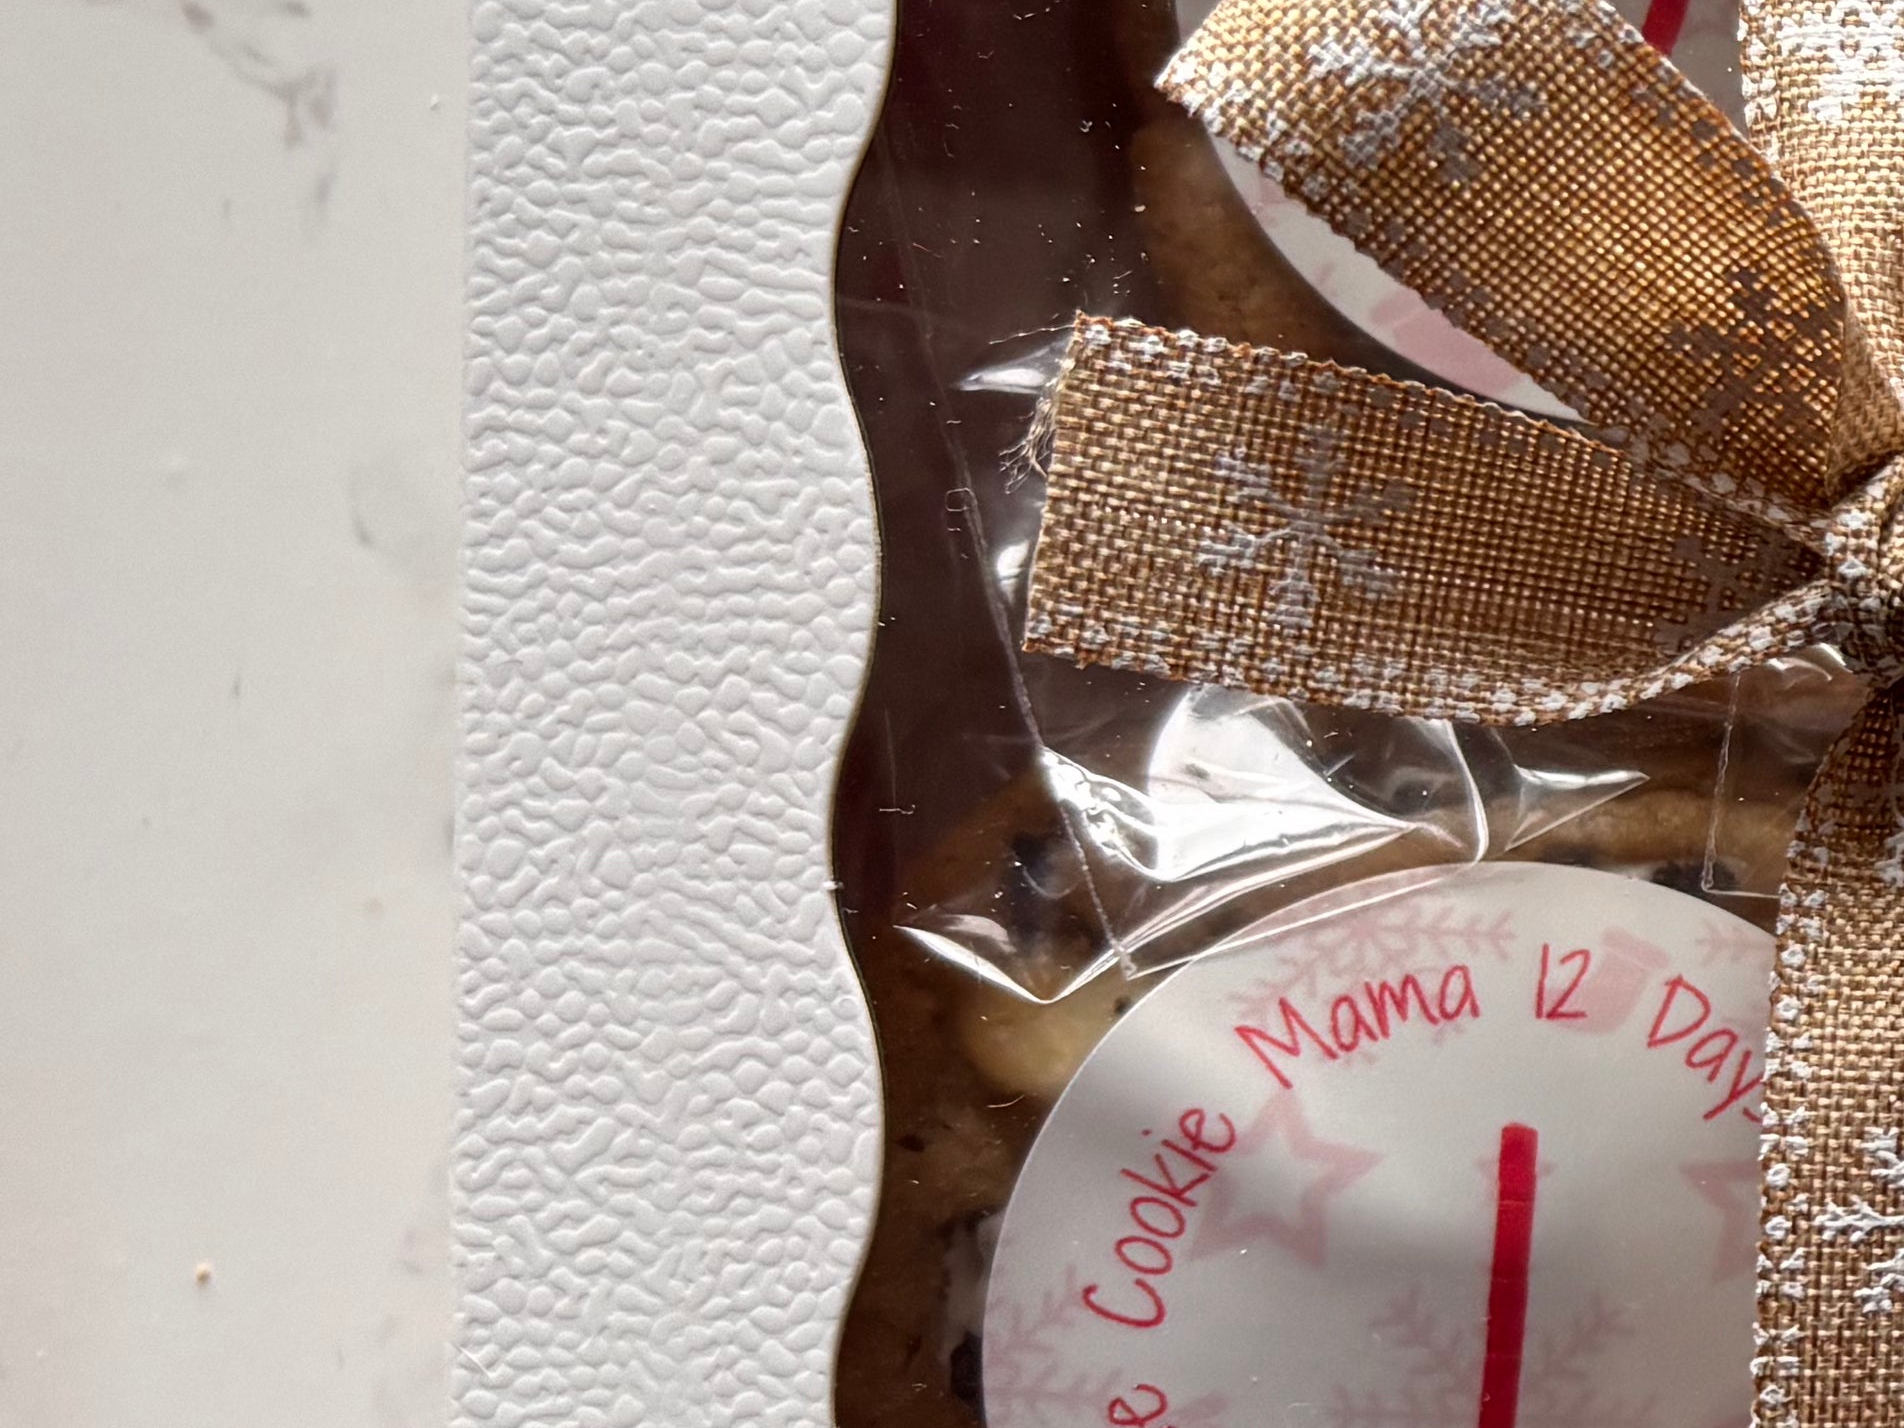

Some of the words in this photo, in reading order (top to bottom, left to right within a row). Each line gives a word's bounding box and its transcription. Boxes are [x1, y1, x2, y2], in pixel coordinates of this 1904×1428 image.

[1083, 1108, 1236, 1329] Cookie
[1233, 964, 1481, 1090] Mama
[1533, 945, 1592, 1022] 12
[1645, 976, 1763, 1124] Day
